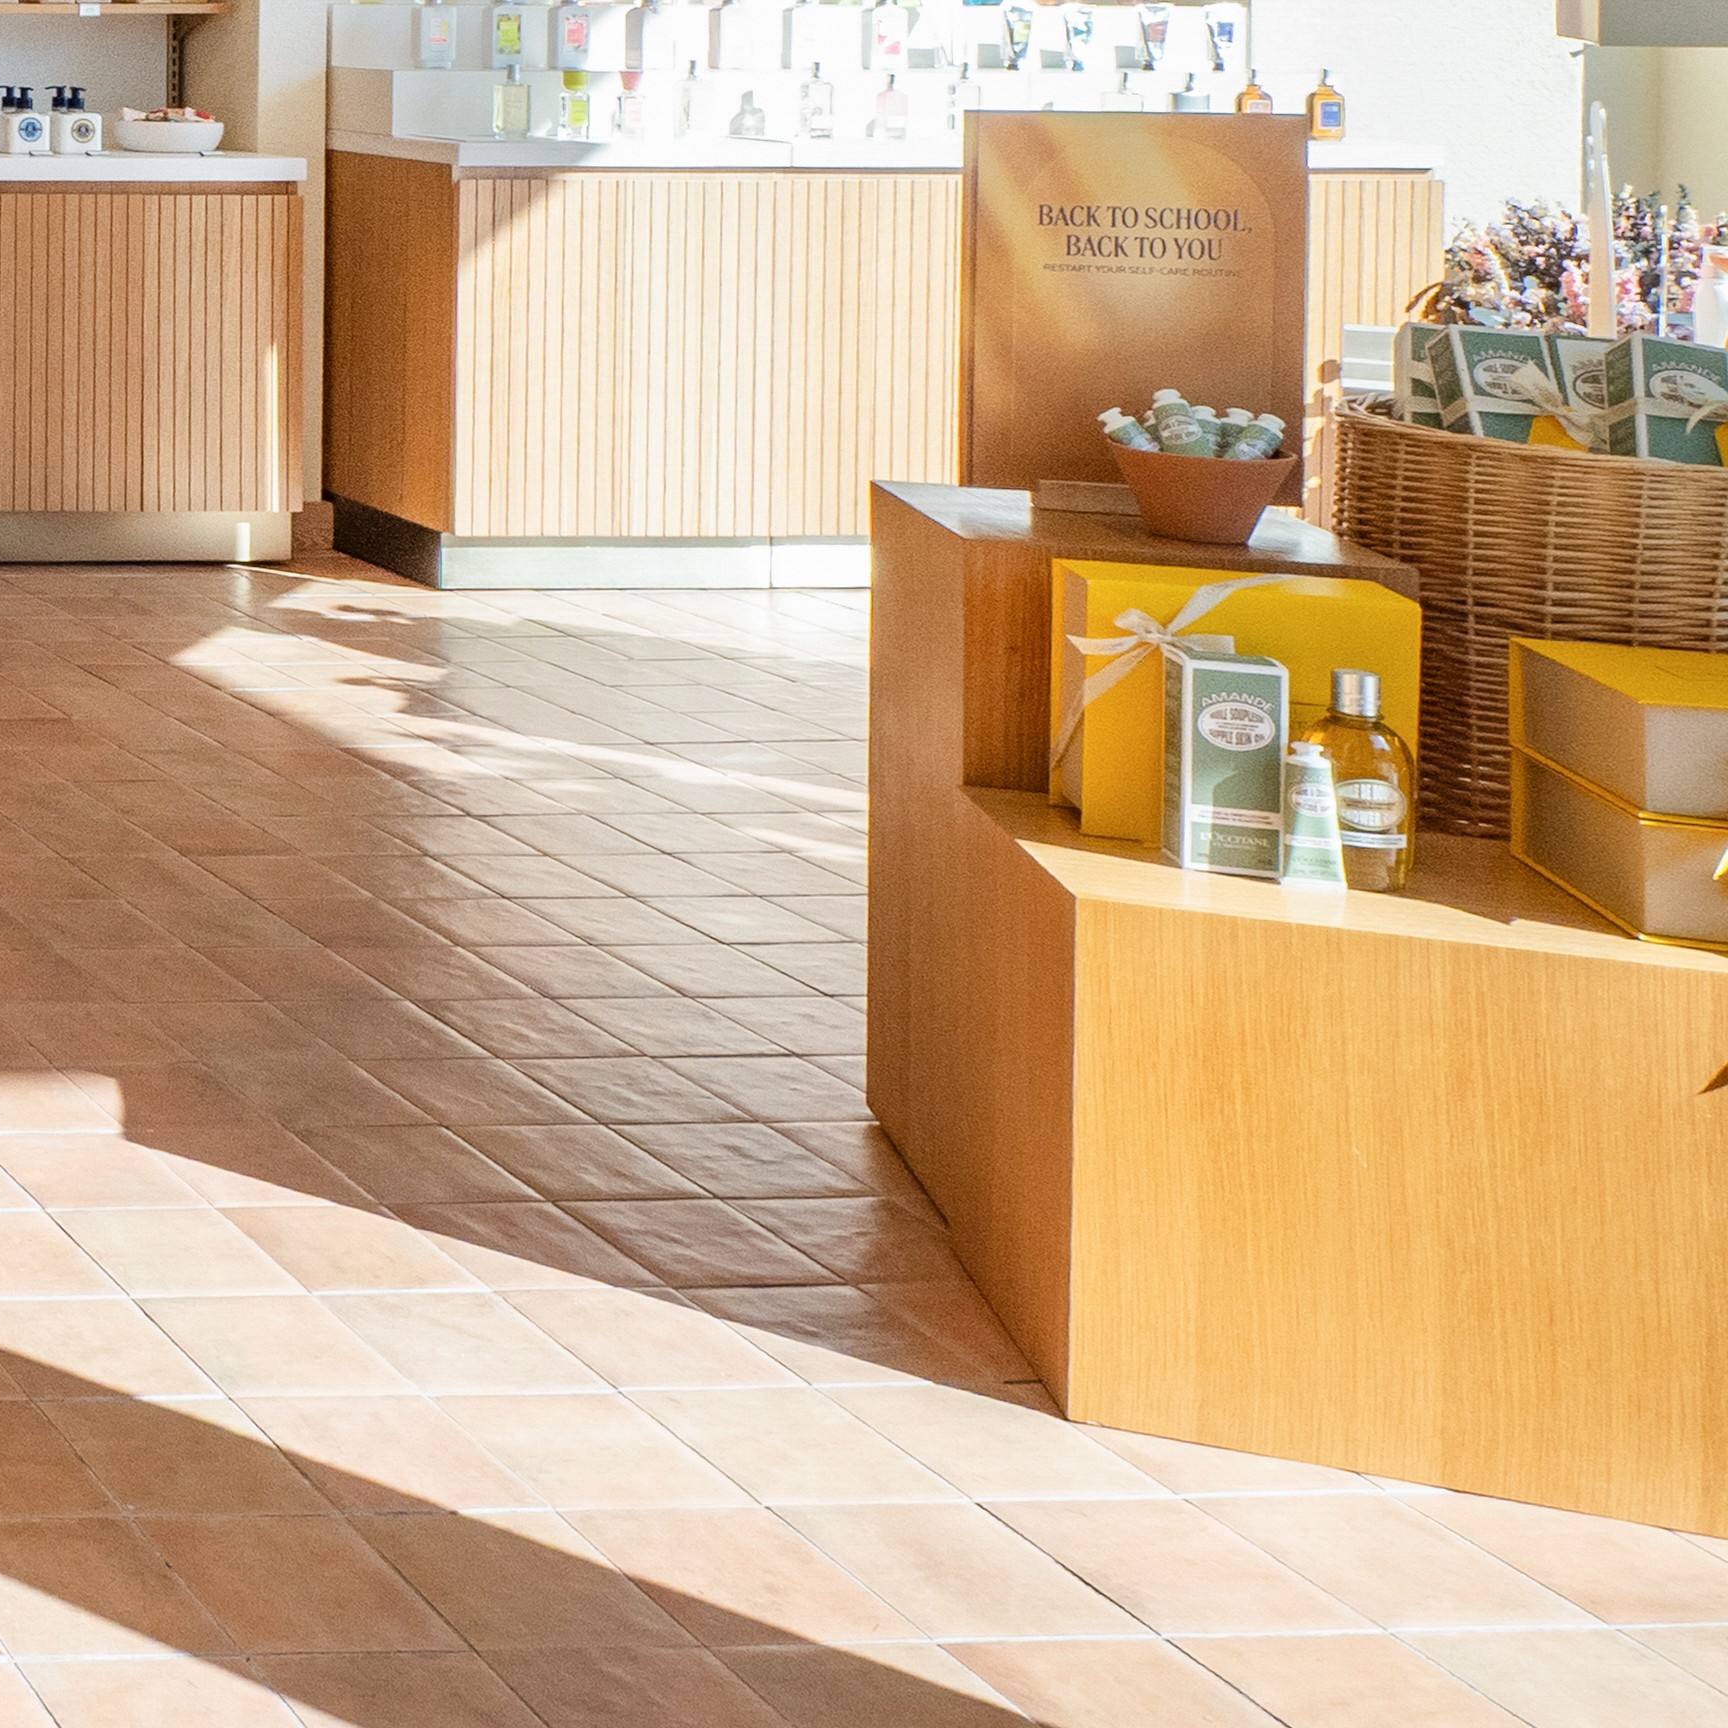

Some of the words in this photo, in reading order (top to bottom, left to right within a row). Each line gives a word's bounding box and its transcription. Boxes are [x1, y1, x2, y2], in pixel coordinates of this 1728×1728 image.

[1038, 204, 1100, 227] BACK
[1106, 206, 1139, 229] TO
[1144, 207, 1253, 234] SCHOOL,
[1066, 235, 1129, 258] BACK
[1134, 236, 1167, 259] TO
[1174, 238, 1223, 261] YOU
[1043, 263, 1092, 273] RESTART
[1094, 265, 1126, 274] YOUR
[1128, 266, 1190, 277] SELF-CARE
[1201, 691, 1276, 713] AMANDE
